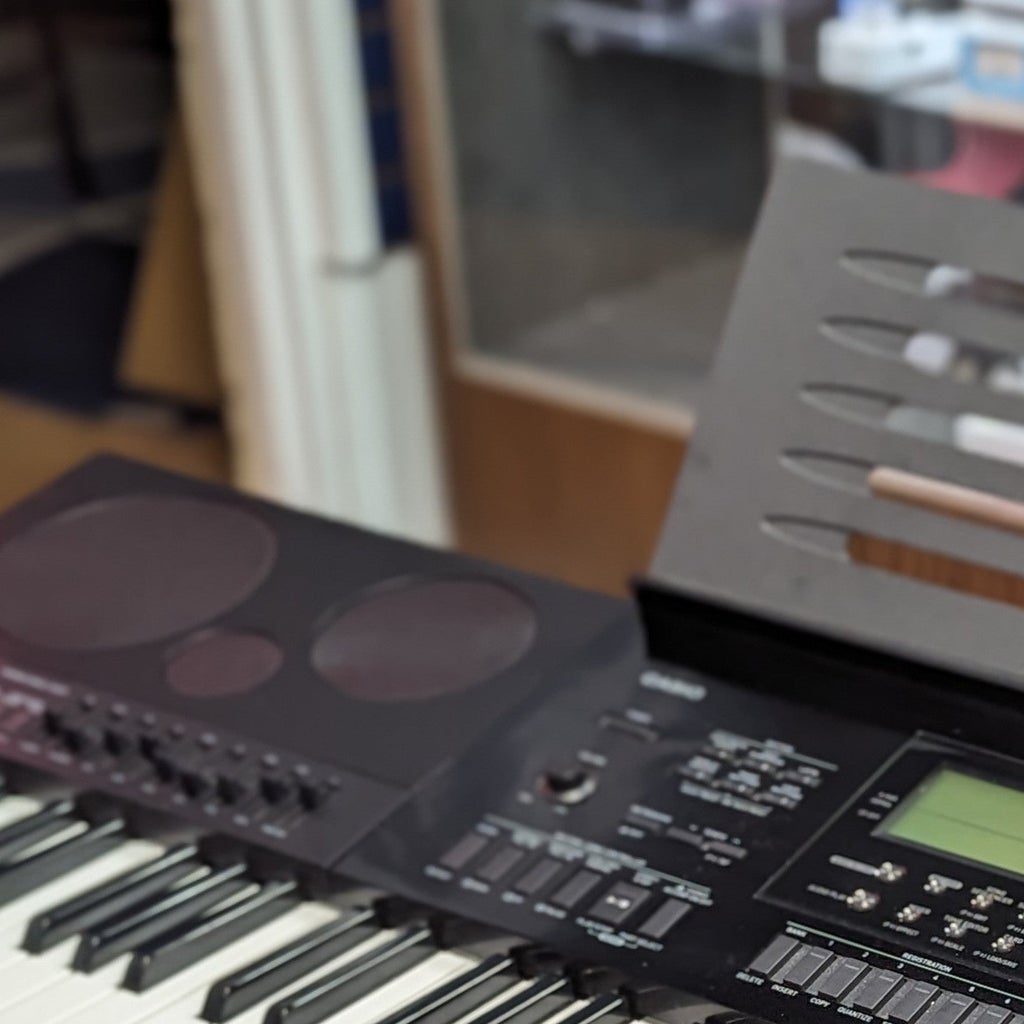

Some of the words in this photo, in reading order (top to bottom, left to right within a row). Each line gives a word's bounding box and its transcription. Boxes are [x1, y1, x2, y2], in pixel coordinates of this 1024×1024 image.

[902, 952, 953, 973] REGISTRATION
[771, 984, 799, 997] INSERT
[810, 997, 831, 1008] COPY
[837, 1006, 873, 1023] QUANTIZE
